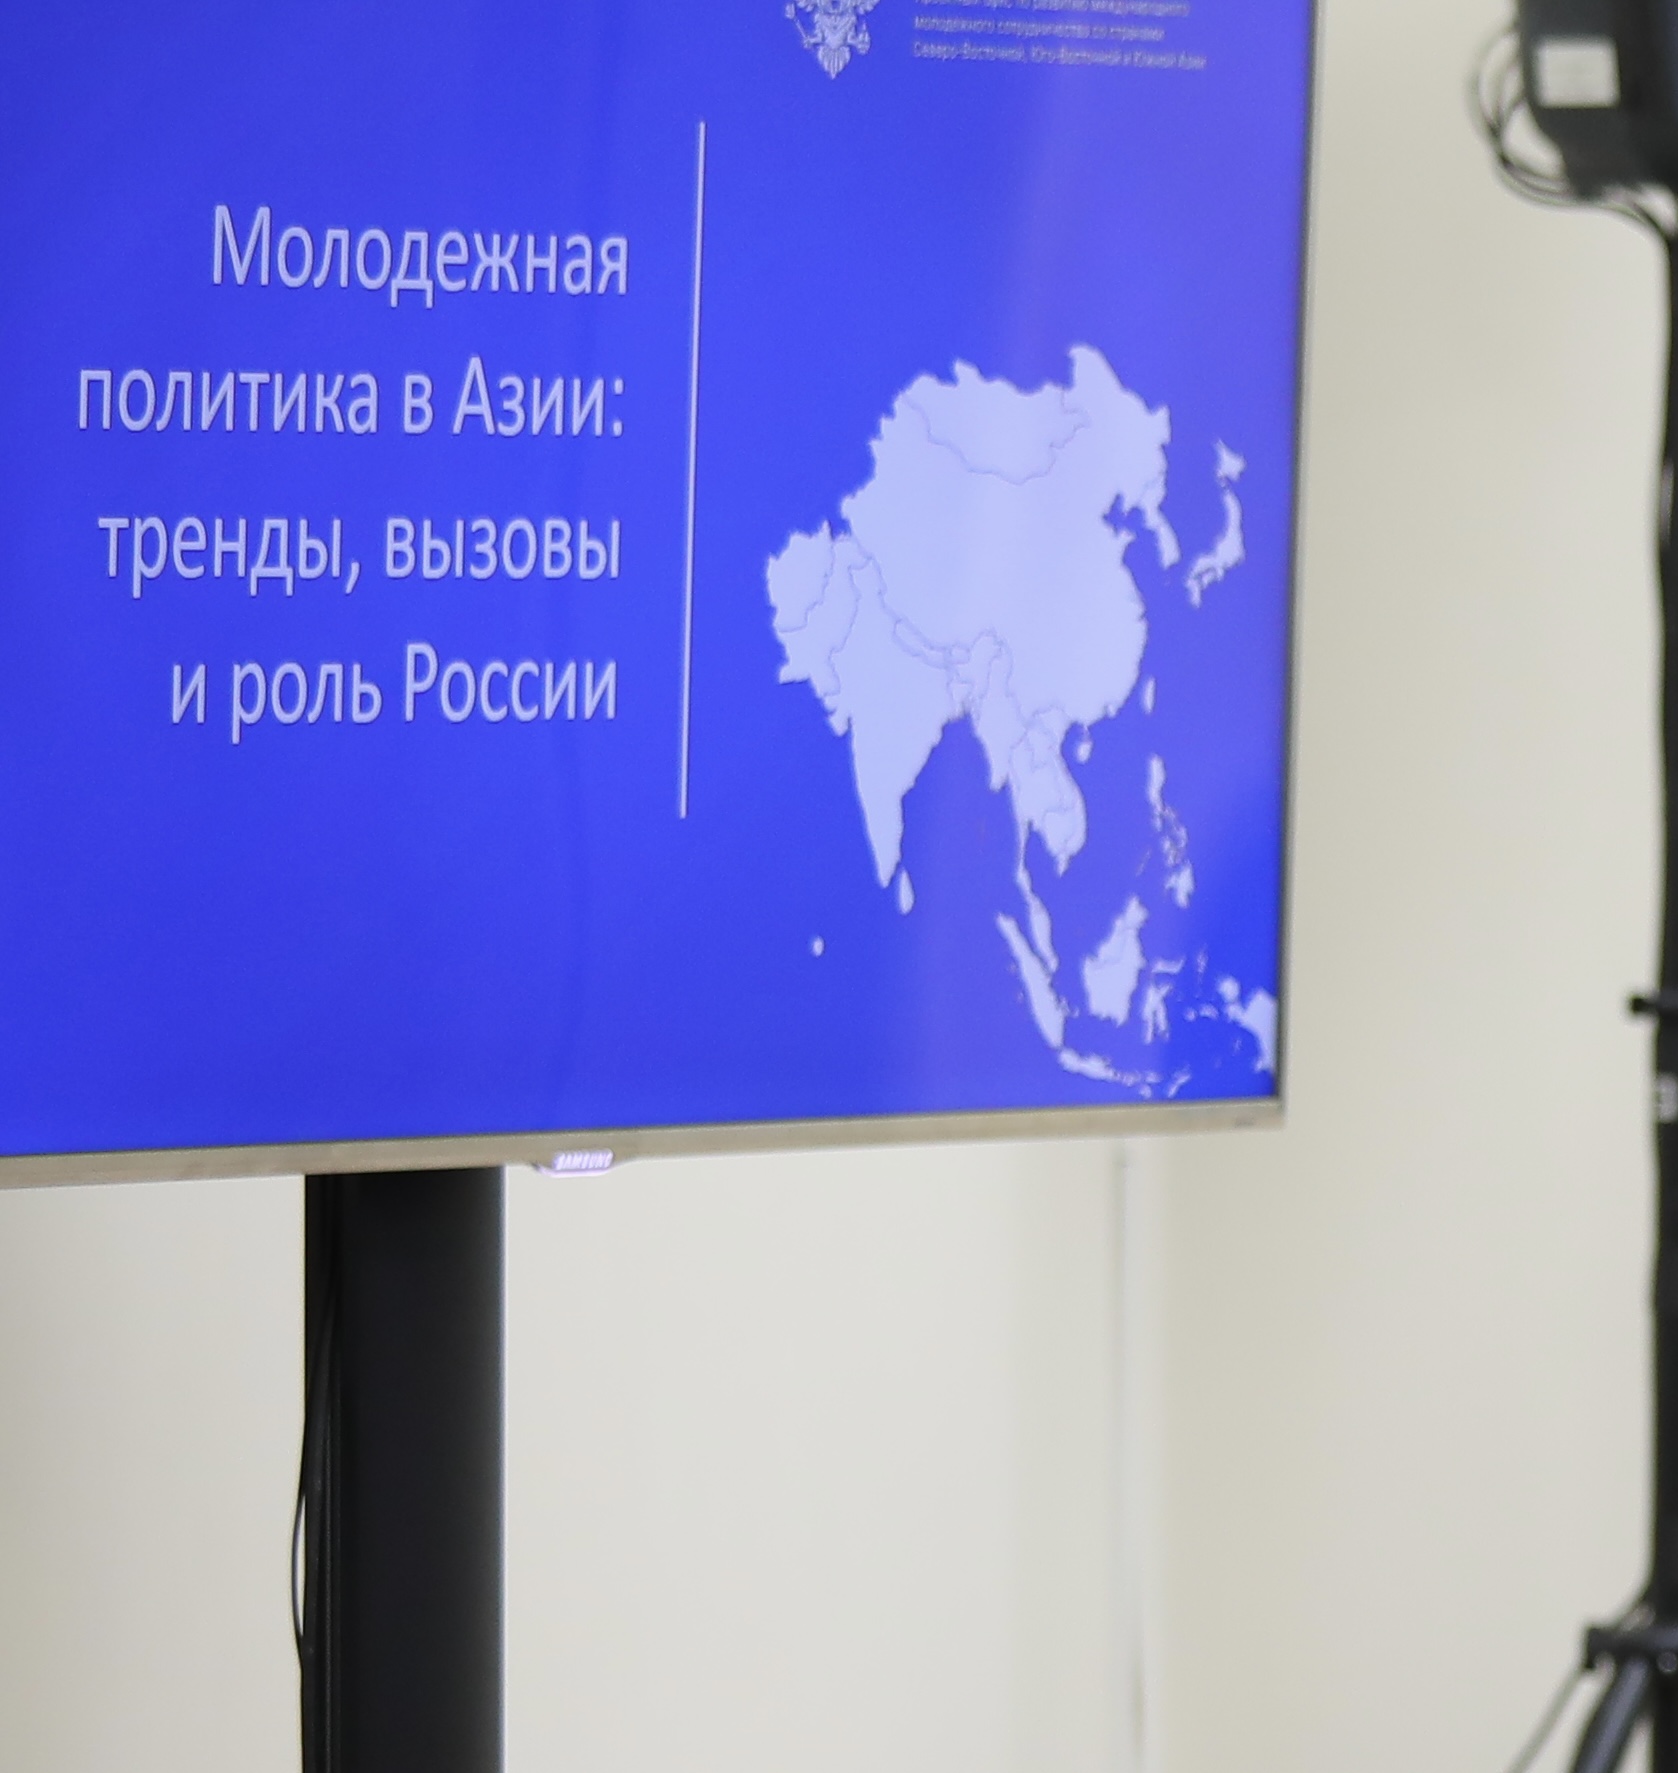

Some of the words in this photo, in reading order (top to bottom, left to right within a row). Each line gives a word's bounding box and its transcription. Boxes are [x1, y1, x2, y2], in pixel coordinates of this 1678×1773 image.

[211, 203, 629, 309] Молодежная
[78, 366, 379, 435] политика
[402, 372, 434, 435] в
[452, 355, 626, 437] Азии:
[97, 515, 361, 600] тренды,
[384, 516, 621, 580] вызовы
[171, 661, 207, 725] и
[230, 660, 383, 745] роль
[404, 641, 618, 723] России
[554, 1151, 613, 1170] SAMSUNG
